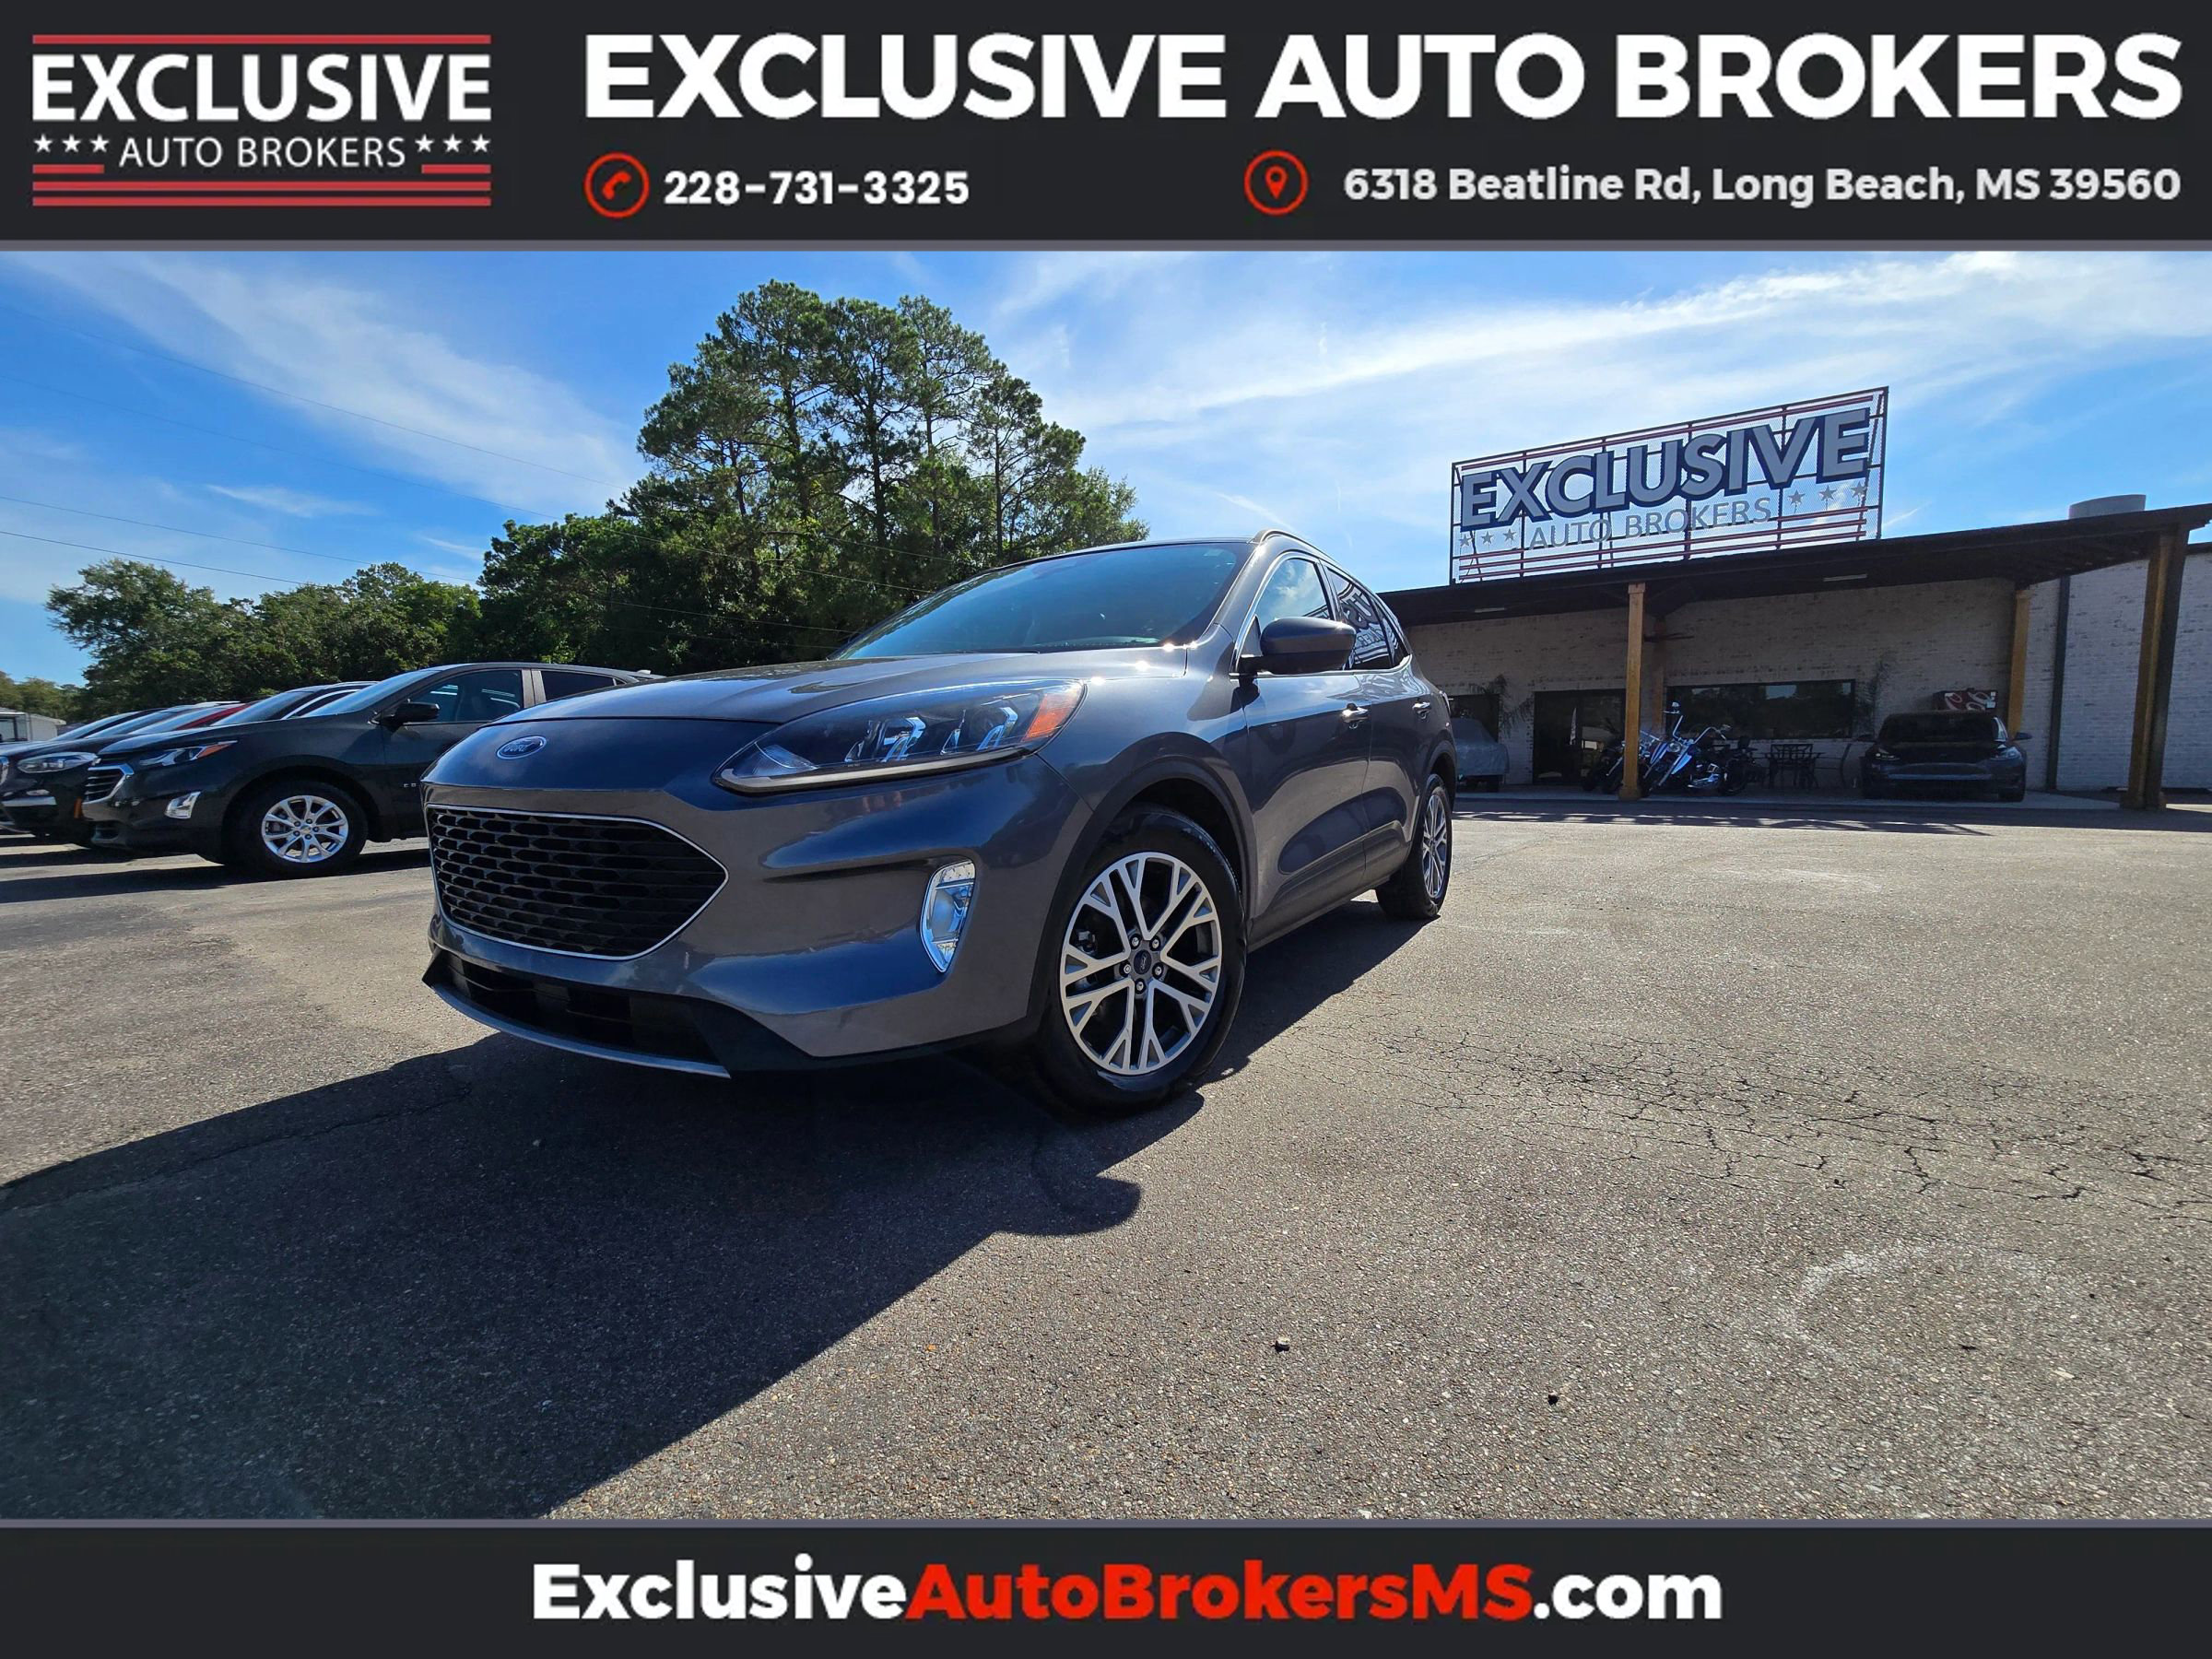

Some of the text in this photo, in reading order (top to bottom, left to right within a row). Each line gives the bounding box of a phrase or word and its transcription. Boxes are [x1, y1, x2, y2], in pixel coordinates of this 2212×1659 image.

[1460, 407, 1870, 532] EXCLUSIVE
[1529, 497, 1771, 550] AUTO BROKERS
